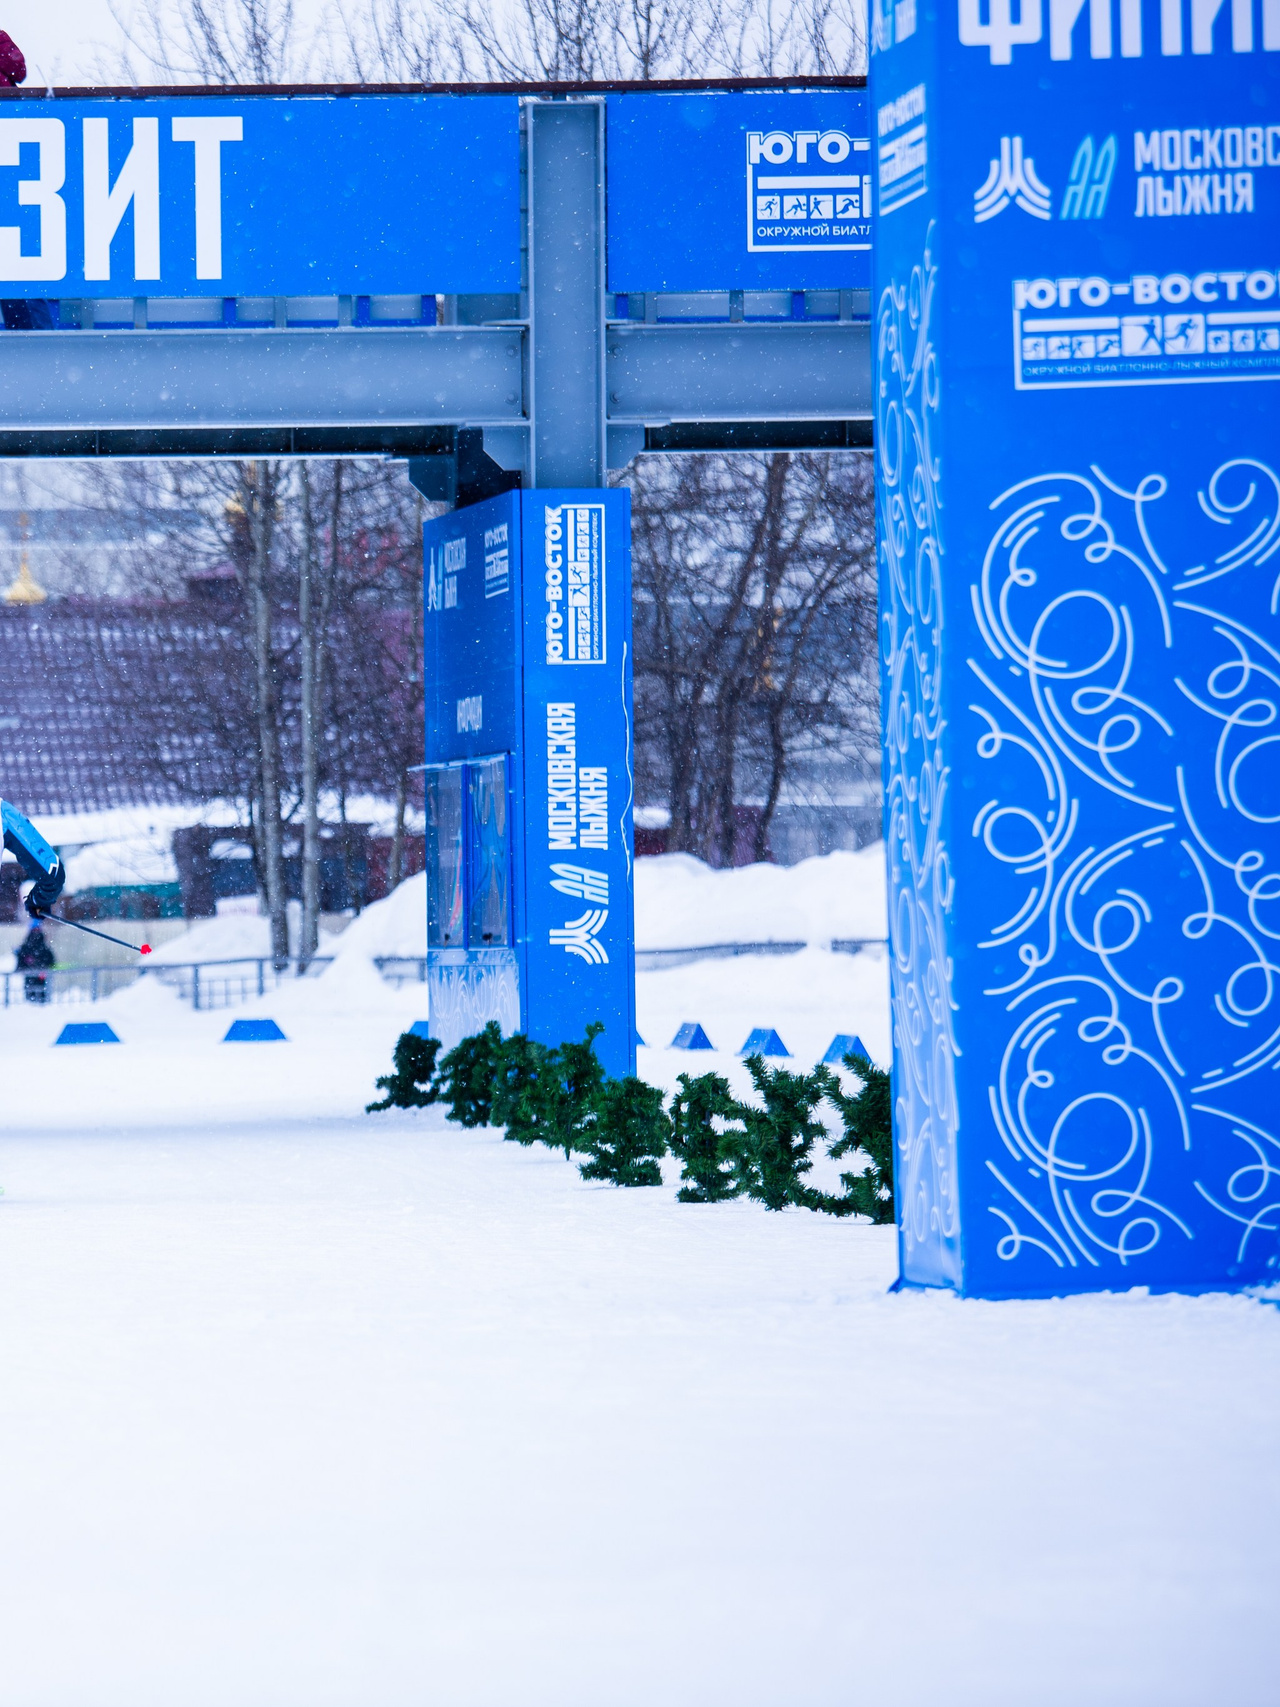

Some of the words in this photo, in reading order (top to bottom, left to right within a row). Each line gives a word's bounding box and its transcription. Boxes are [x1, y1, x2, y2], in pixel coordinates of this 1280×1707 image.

[1134, 172, 1254, 217] ЛЫЖНЯ
[757, 223, 830, 237] ОКРУЖНОЙ
[1013, 270, 1280, 310] ЮГО-ВОСТО
[545, 506, 563, 665] ЮГО-ВОСТОК
[546, 702, 577, 851] МОСКОВСКАЯ
[578, 766, 608, 851] ЛЫЖНЯ
